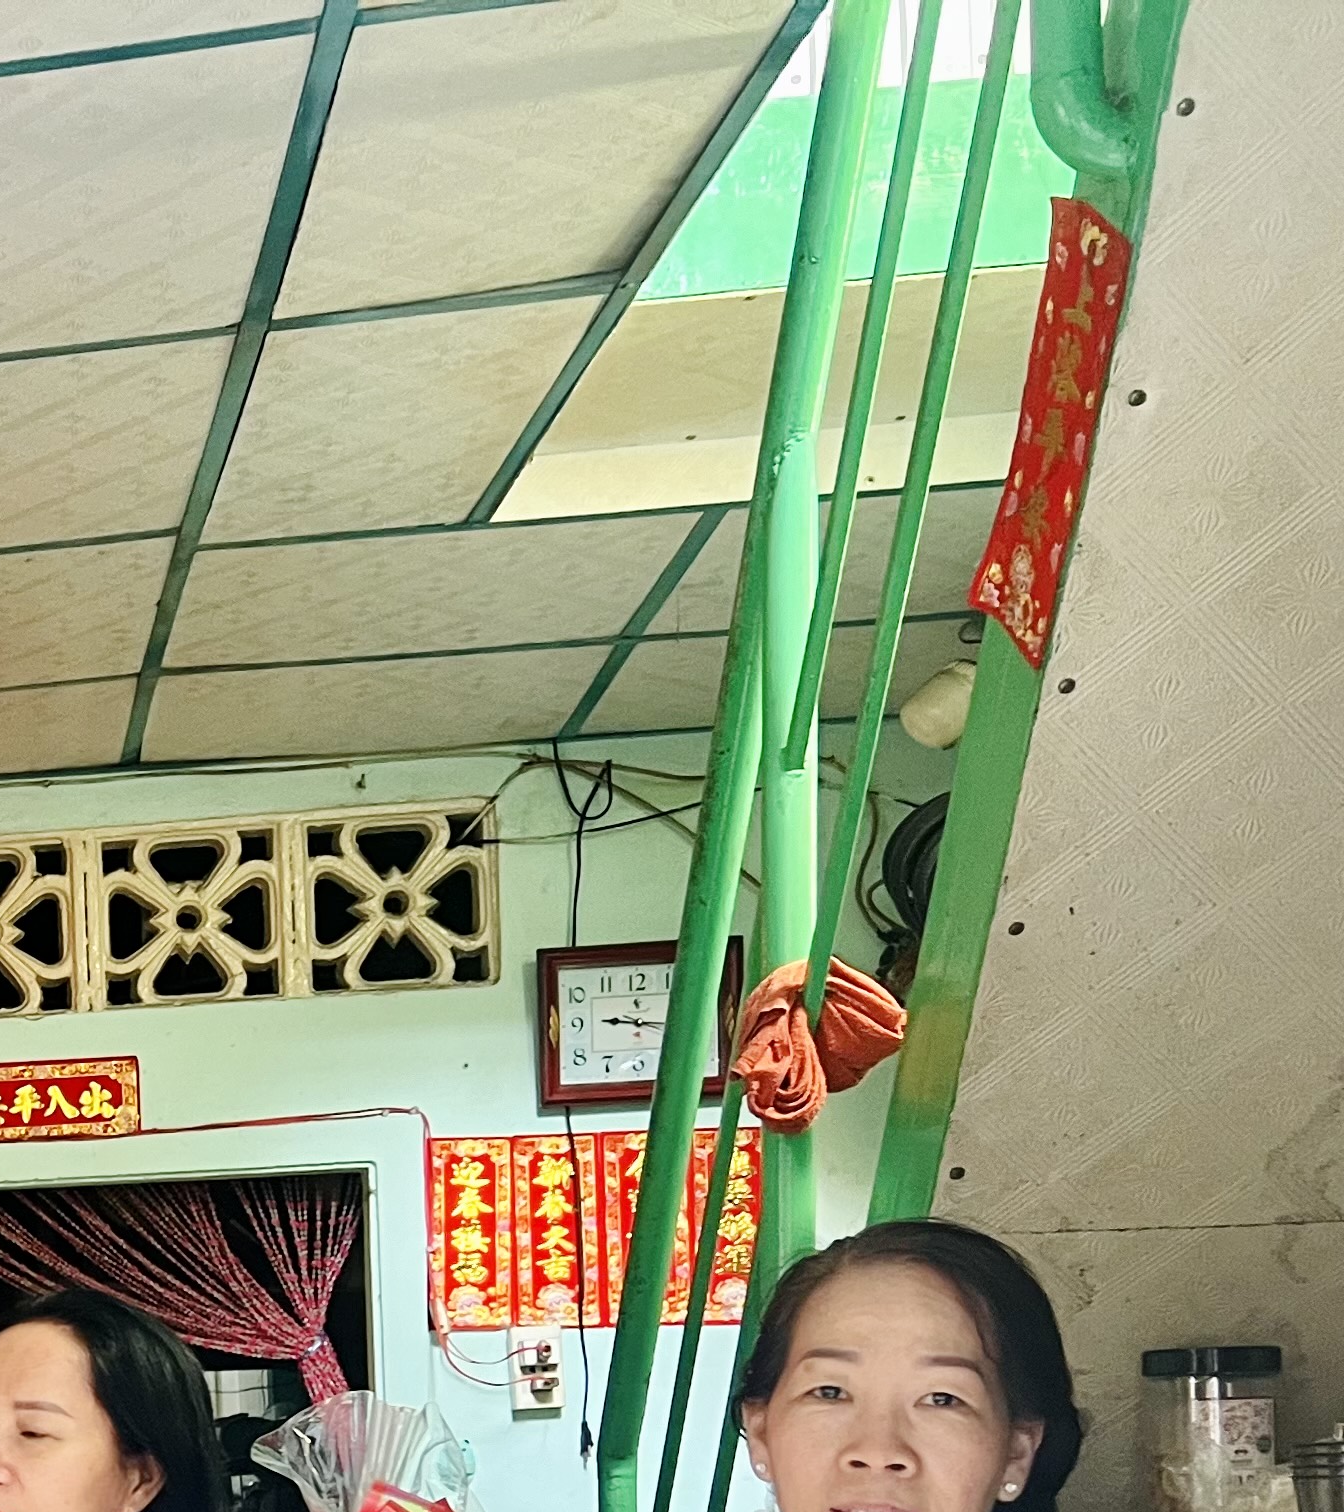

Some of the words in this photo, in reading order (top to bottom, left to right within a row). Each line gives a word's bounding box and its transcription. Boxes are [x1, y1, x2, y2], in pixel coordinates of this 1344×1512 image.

[600, 976, 612, 993] 11
[628, 973, 646, 992] 12
[569, 986, 586, 1004] 10
[571, 1017, 584, 1033] 9
[573, 1048, 587, 1066] 8
[601, 1055, 614, 1073] 7
[450, 1155, 494, 1284] 迎春接福
[532, 1154, 576, 1282] 新春大吉
